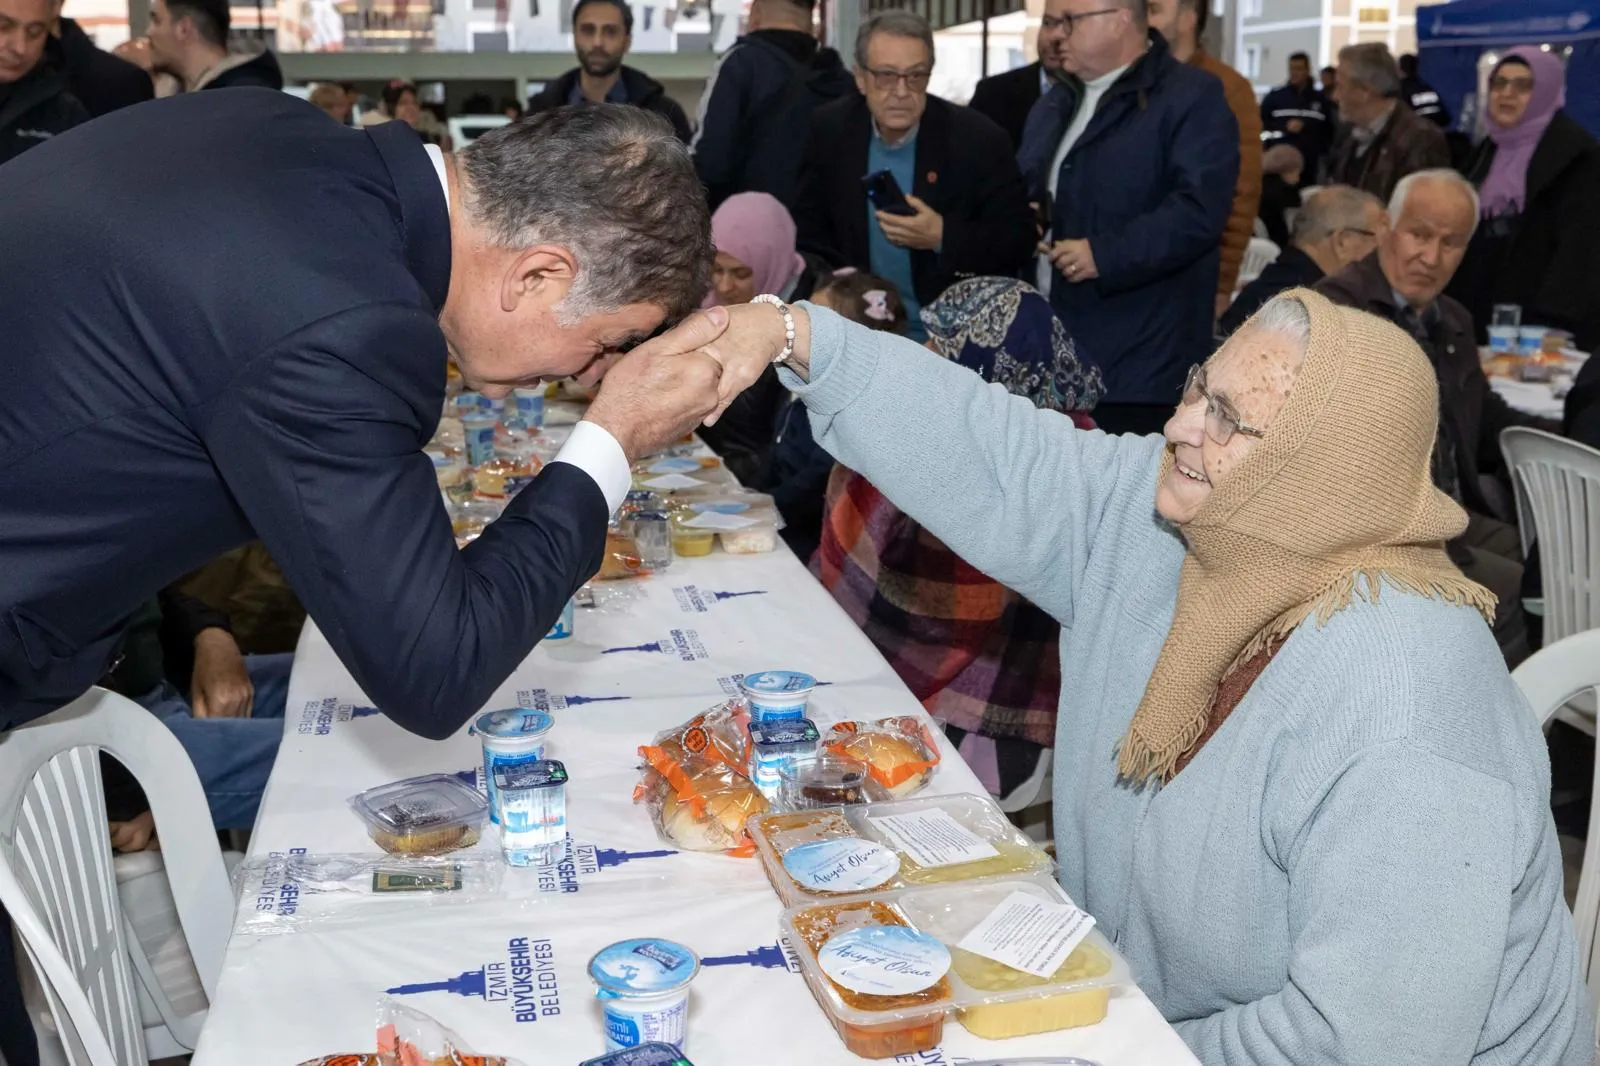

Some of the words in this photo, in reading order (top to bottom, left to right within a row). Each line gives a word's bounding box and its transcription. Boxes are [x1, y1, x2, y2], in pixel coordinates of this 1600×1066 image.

[486, 962, 509, 1002] İZMİR
[507, 936, 537, 1023] BÜYÜKŞEHİR
[531, 939, 561, 1016] BELEDİYESİ
